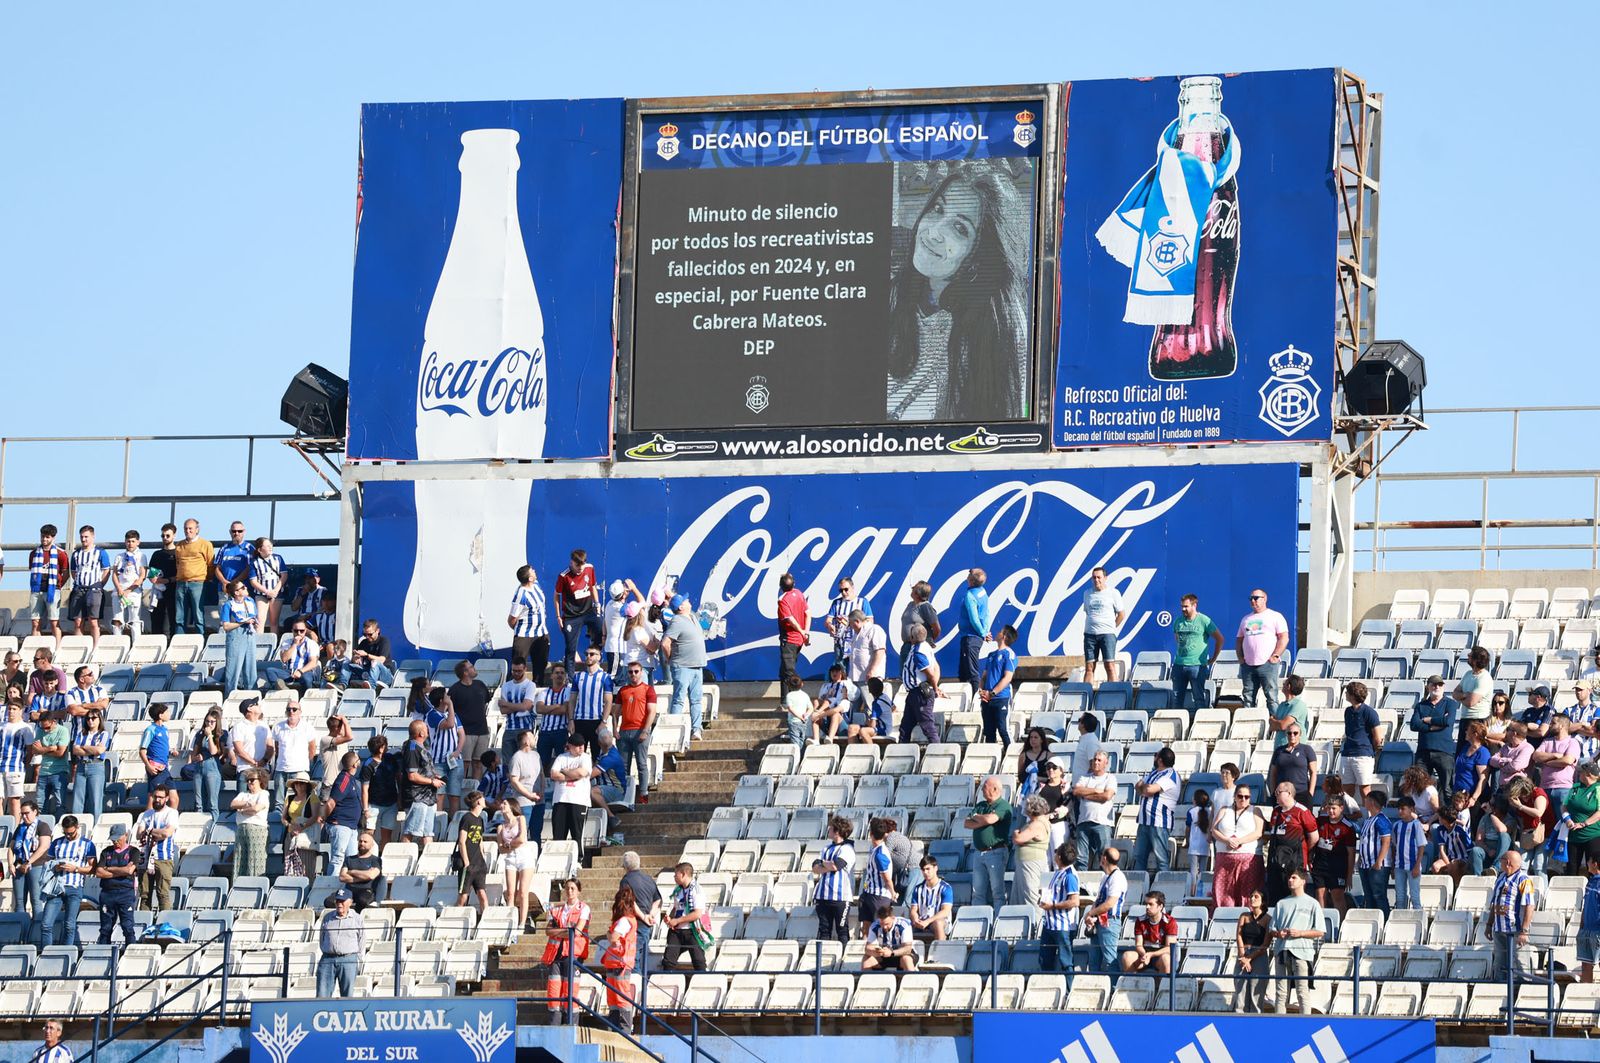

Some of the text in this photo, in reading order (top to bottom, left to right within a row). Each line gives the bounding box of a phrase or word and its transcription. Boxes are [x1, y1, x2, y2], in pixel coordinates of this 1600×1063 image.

[692, 124, 989, 151] DECANO DEL FÚTBOL ESPAÑOL
[688, 203, 838, 223] Minuto de silencio
[651, 229, 874, 255] por todos los recreativistas
[667, 258, 855, 277] fallecidos en 2024 y, en
[655, 283, 867, 308] especial, por Fuente Clara
[692, 312, 827, 330] Cabrera Mateos.
[743, 340, 775, 355] DEP
[420, 347, 544, 418] Coca-Cola
[1065, 383, 1188, 404] Refresco Oficial del:
[1064, 404, 1221, 427] R.C. Recreativo de Huelva
[721, 433, 945, 456] www.alosonido.net
[1064, 426, 1221, 442] Decano del fútbol español Fundado en 1889
[648, 478, 1195, 664] Coca-Cola
[312, 1009, 453, 1033] CAJA RURAL
[346, 1046, 419, 1061] DEL SUR
